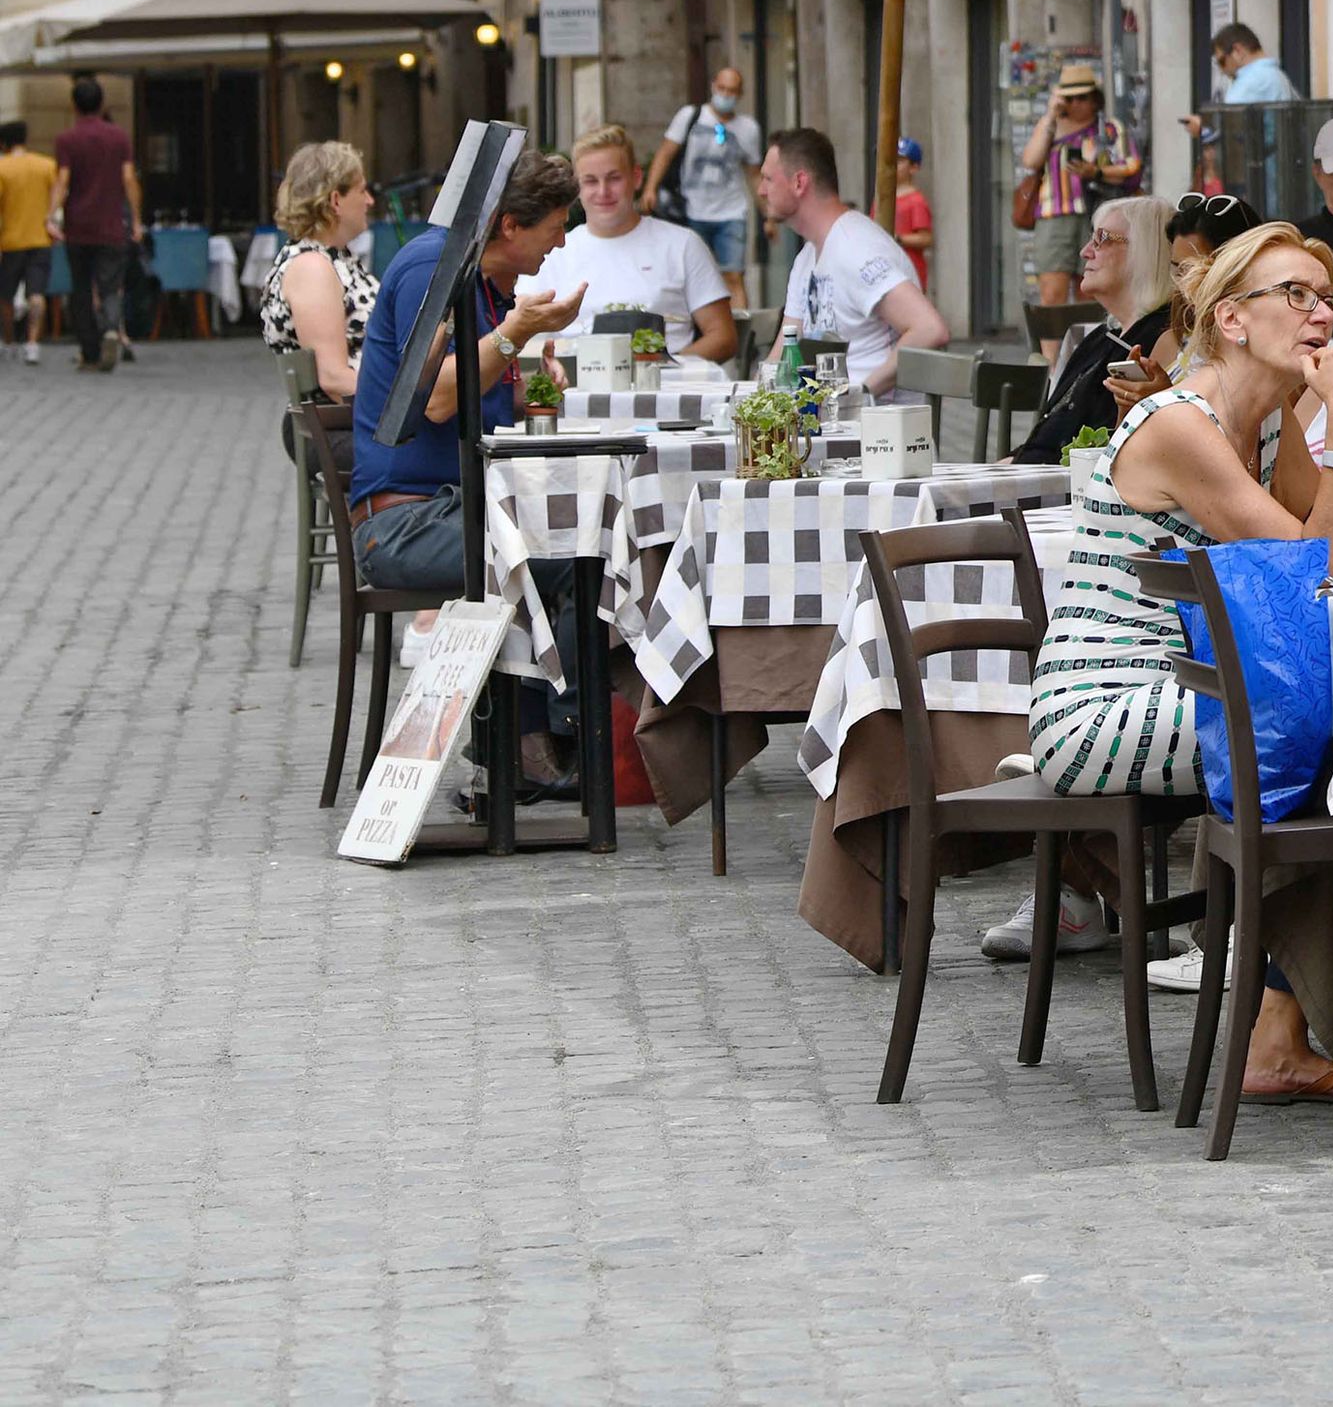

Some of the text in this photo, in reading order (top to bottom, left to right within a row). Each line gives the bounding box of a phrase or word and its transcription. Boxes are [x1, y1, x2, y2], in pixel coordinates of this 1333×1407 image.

[378, 763, 423, 791] PASTA
[380, 799, 398, 816] or
[355, 818, 399, 845] PIZZA
